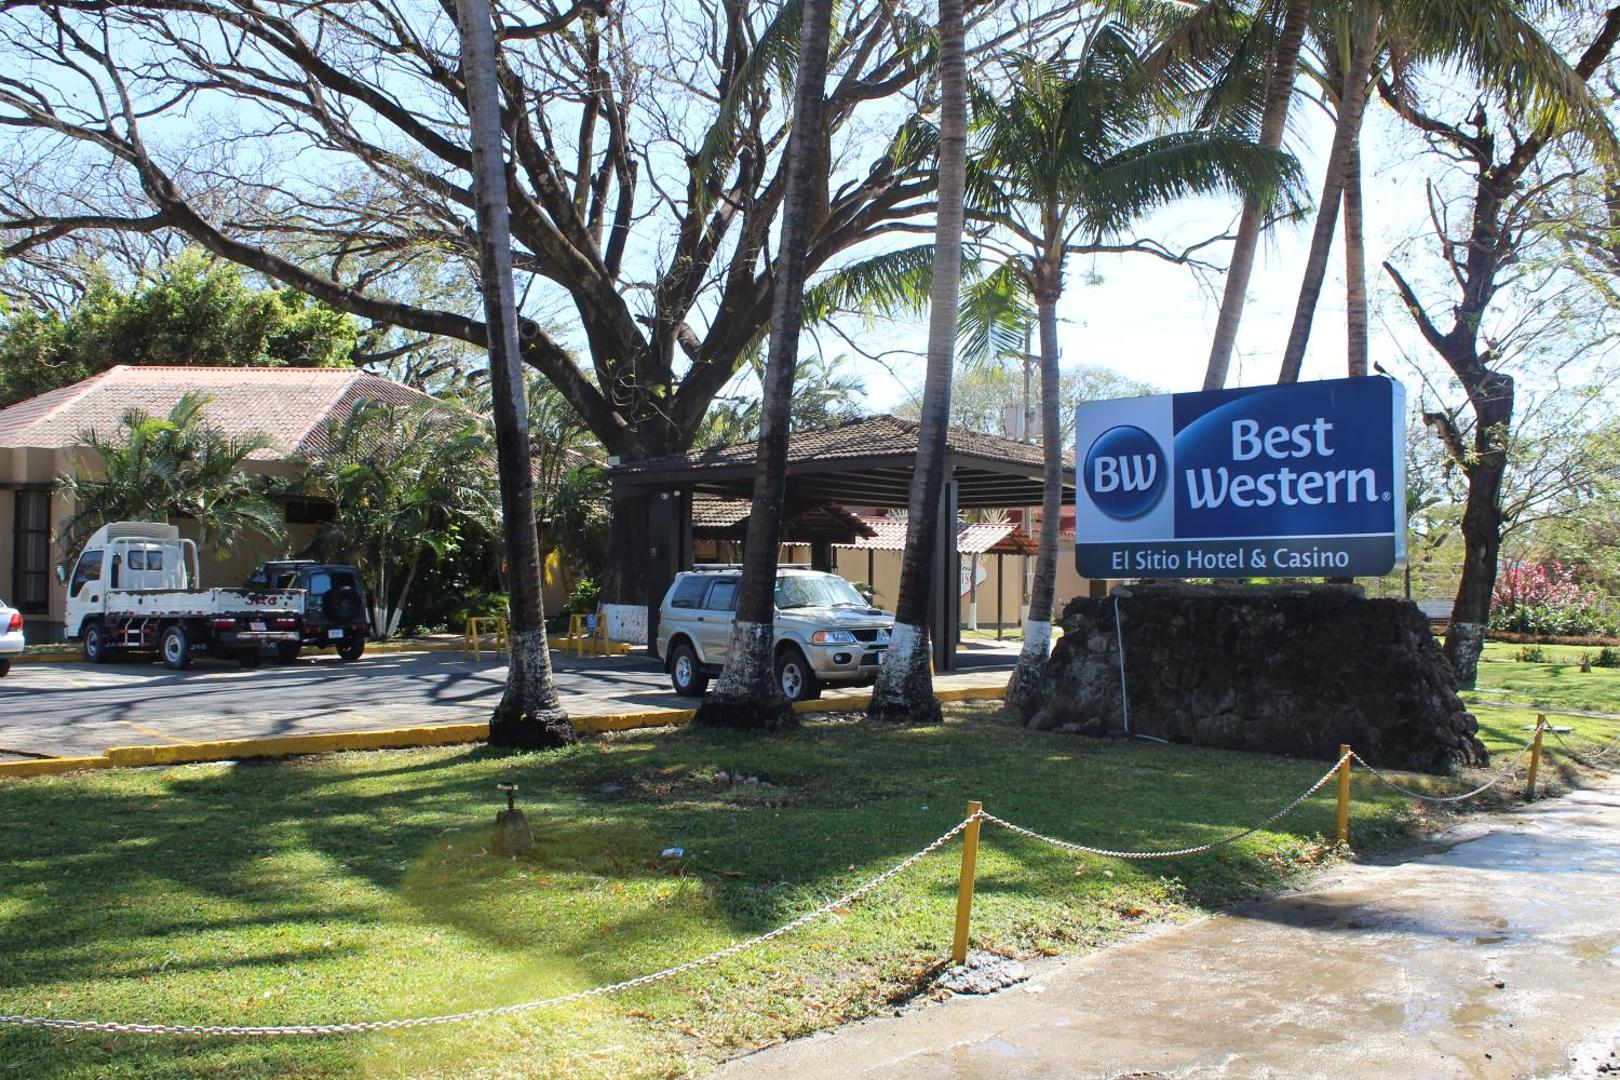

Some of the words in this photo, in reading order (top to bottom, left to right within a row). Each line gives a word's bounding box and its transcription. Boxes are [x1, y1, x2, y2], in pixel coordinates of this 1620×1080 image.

[1232, 418, 1334, 461] Best
[1094, 453, 1157, 493] BW
[1185, 467, 1378, 509] Western
[1112, 551, 1129, 570] El
[1136, 551, 1180, 569] Sitio
[1187, 549, 1244, 569] Hotel
[1251, 549, 1267, 568] &
[1274, 547, 1349, 567] Casino
